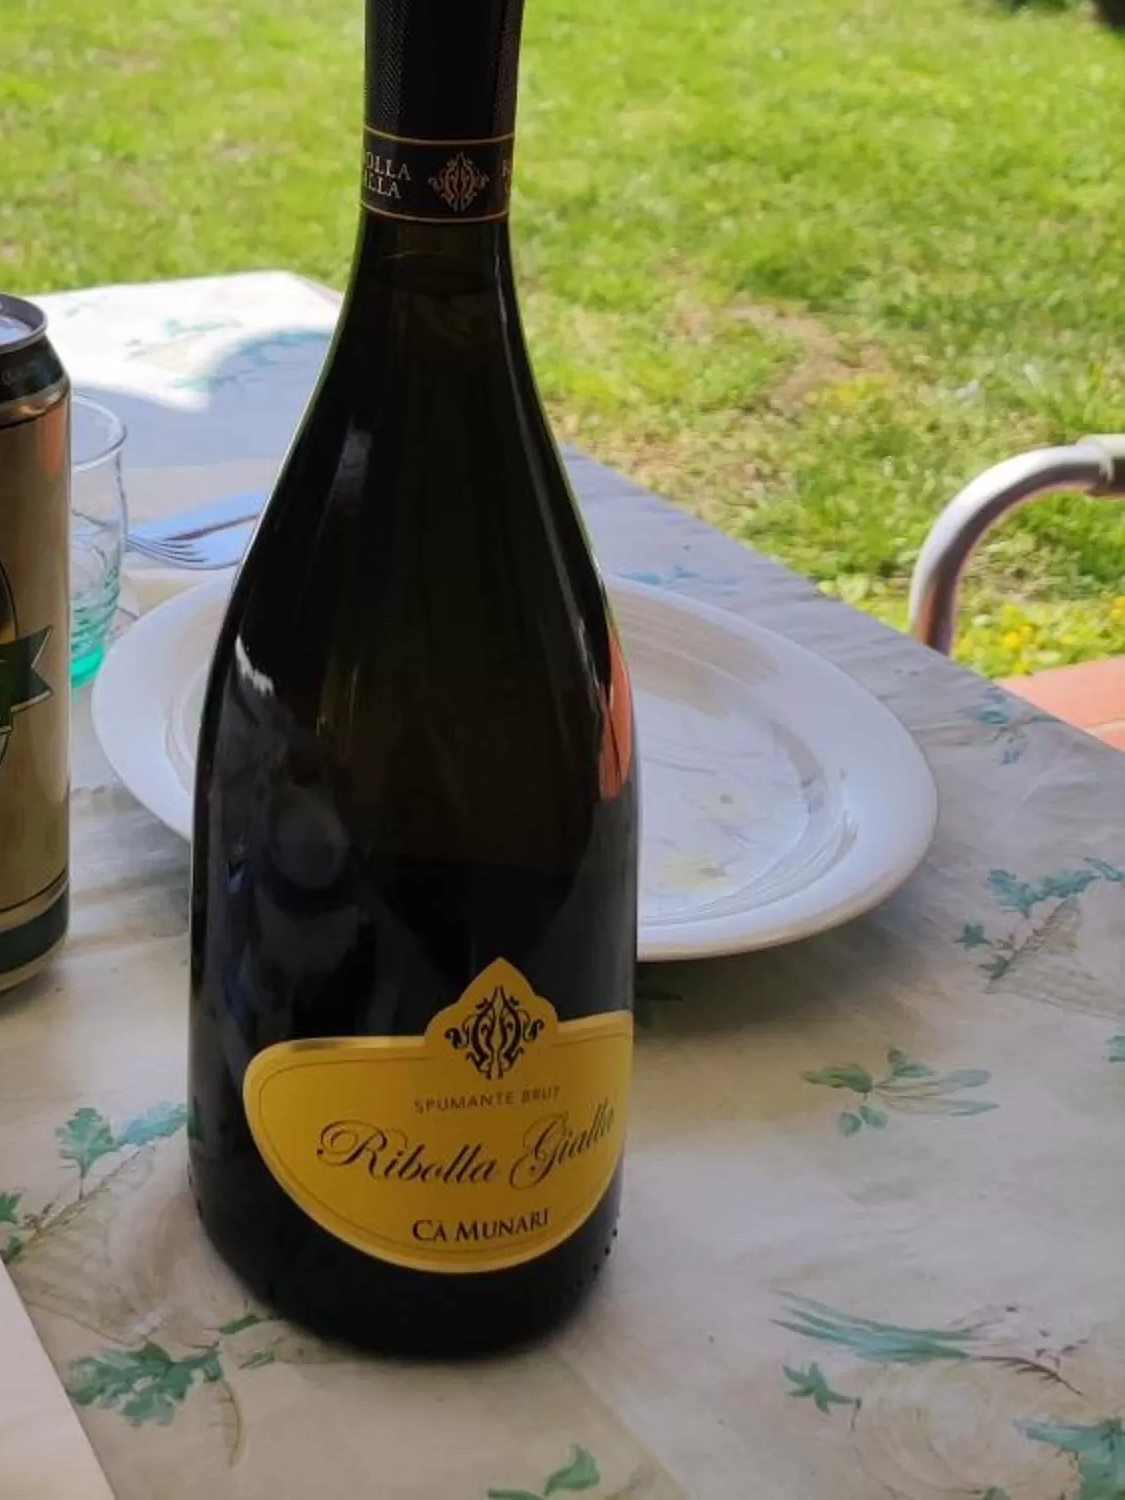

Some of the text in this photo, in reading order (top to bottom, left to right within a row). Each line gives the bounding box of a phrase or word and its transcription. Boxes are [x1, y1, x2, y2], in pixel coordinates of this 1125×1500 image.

[413, 1085, 562, 1114] SPUMANTE BRUT
[316, 1097, 617, 1192] Ribolla Gialla
[454, 1207, 549, 1243] MUNARI
